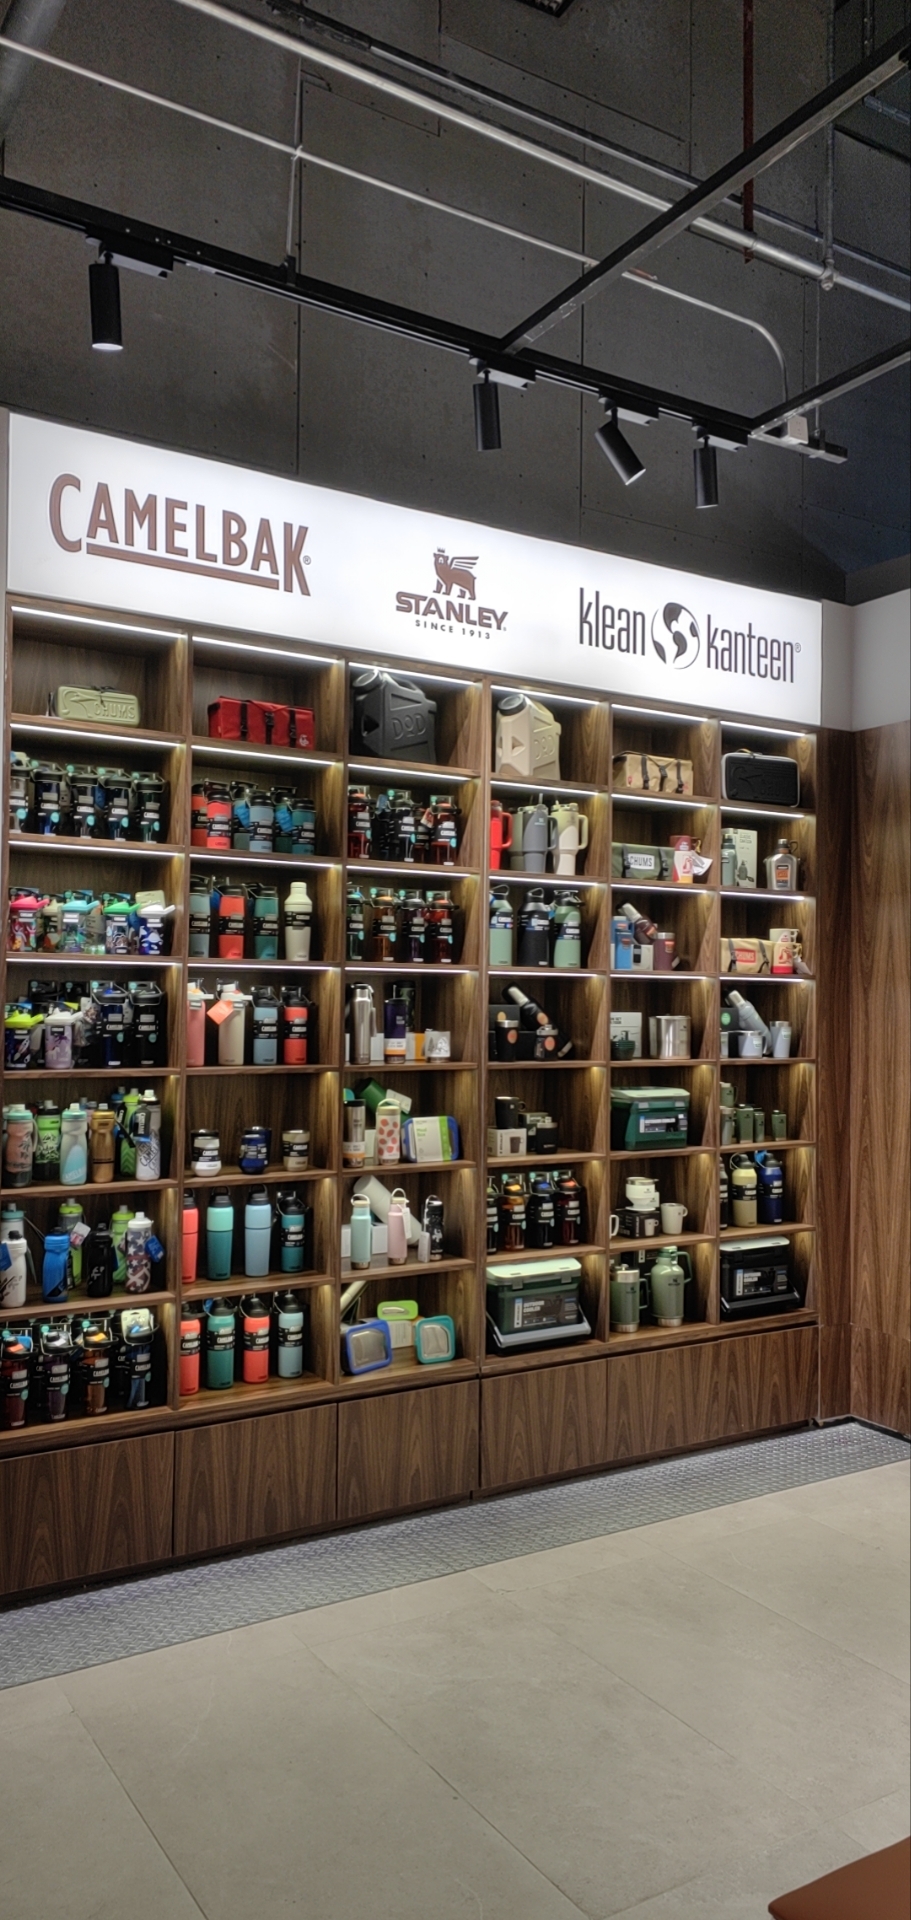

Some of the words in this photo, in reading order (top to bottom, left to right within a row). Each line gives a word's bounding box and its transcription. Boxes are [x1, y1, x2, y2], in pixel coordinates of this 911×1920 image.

[395, 591, 508, 631] STANLEY
[579, 587, 646, 656] klean
[415, 619, 454, 633] SINCE
[462, 627, 491, 640] 1913
[94, 702, 136, 719] CHUMS
[629, 855, 653, 868] CHUMS
